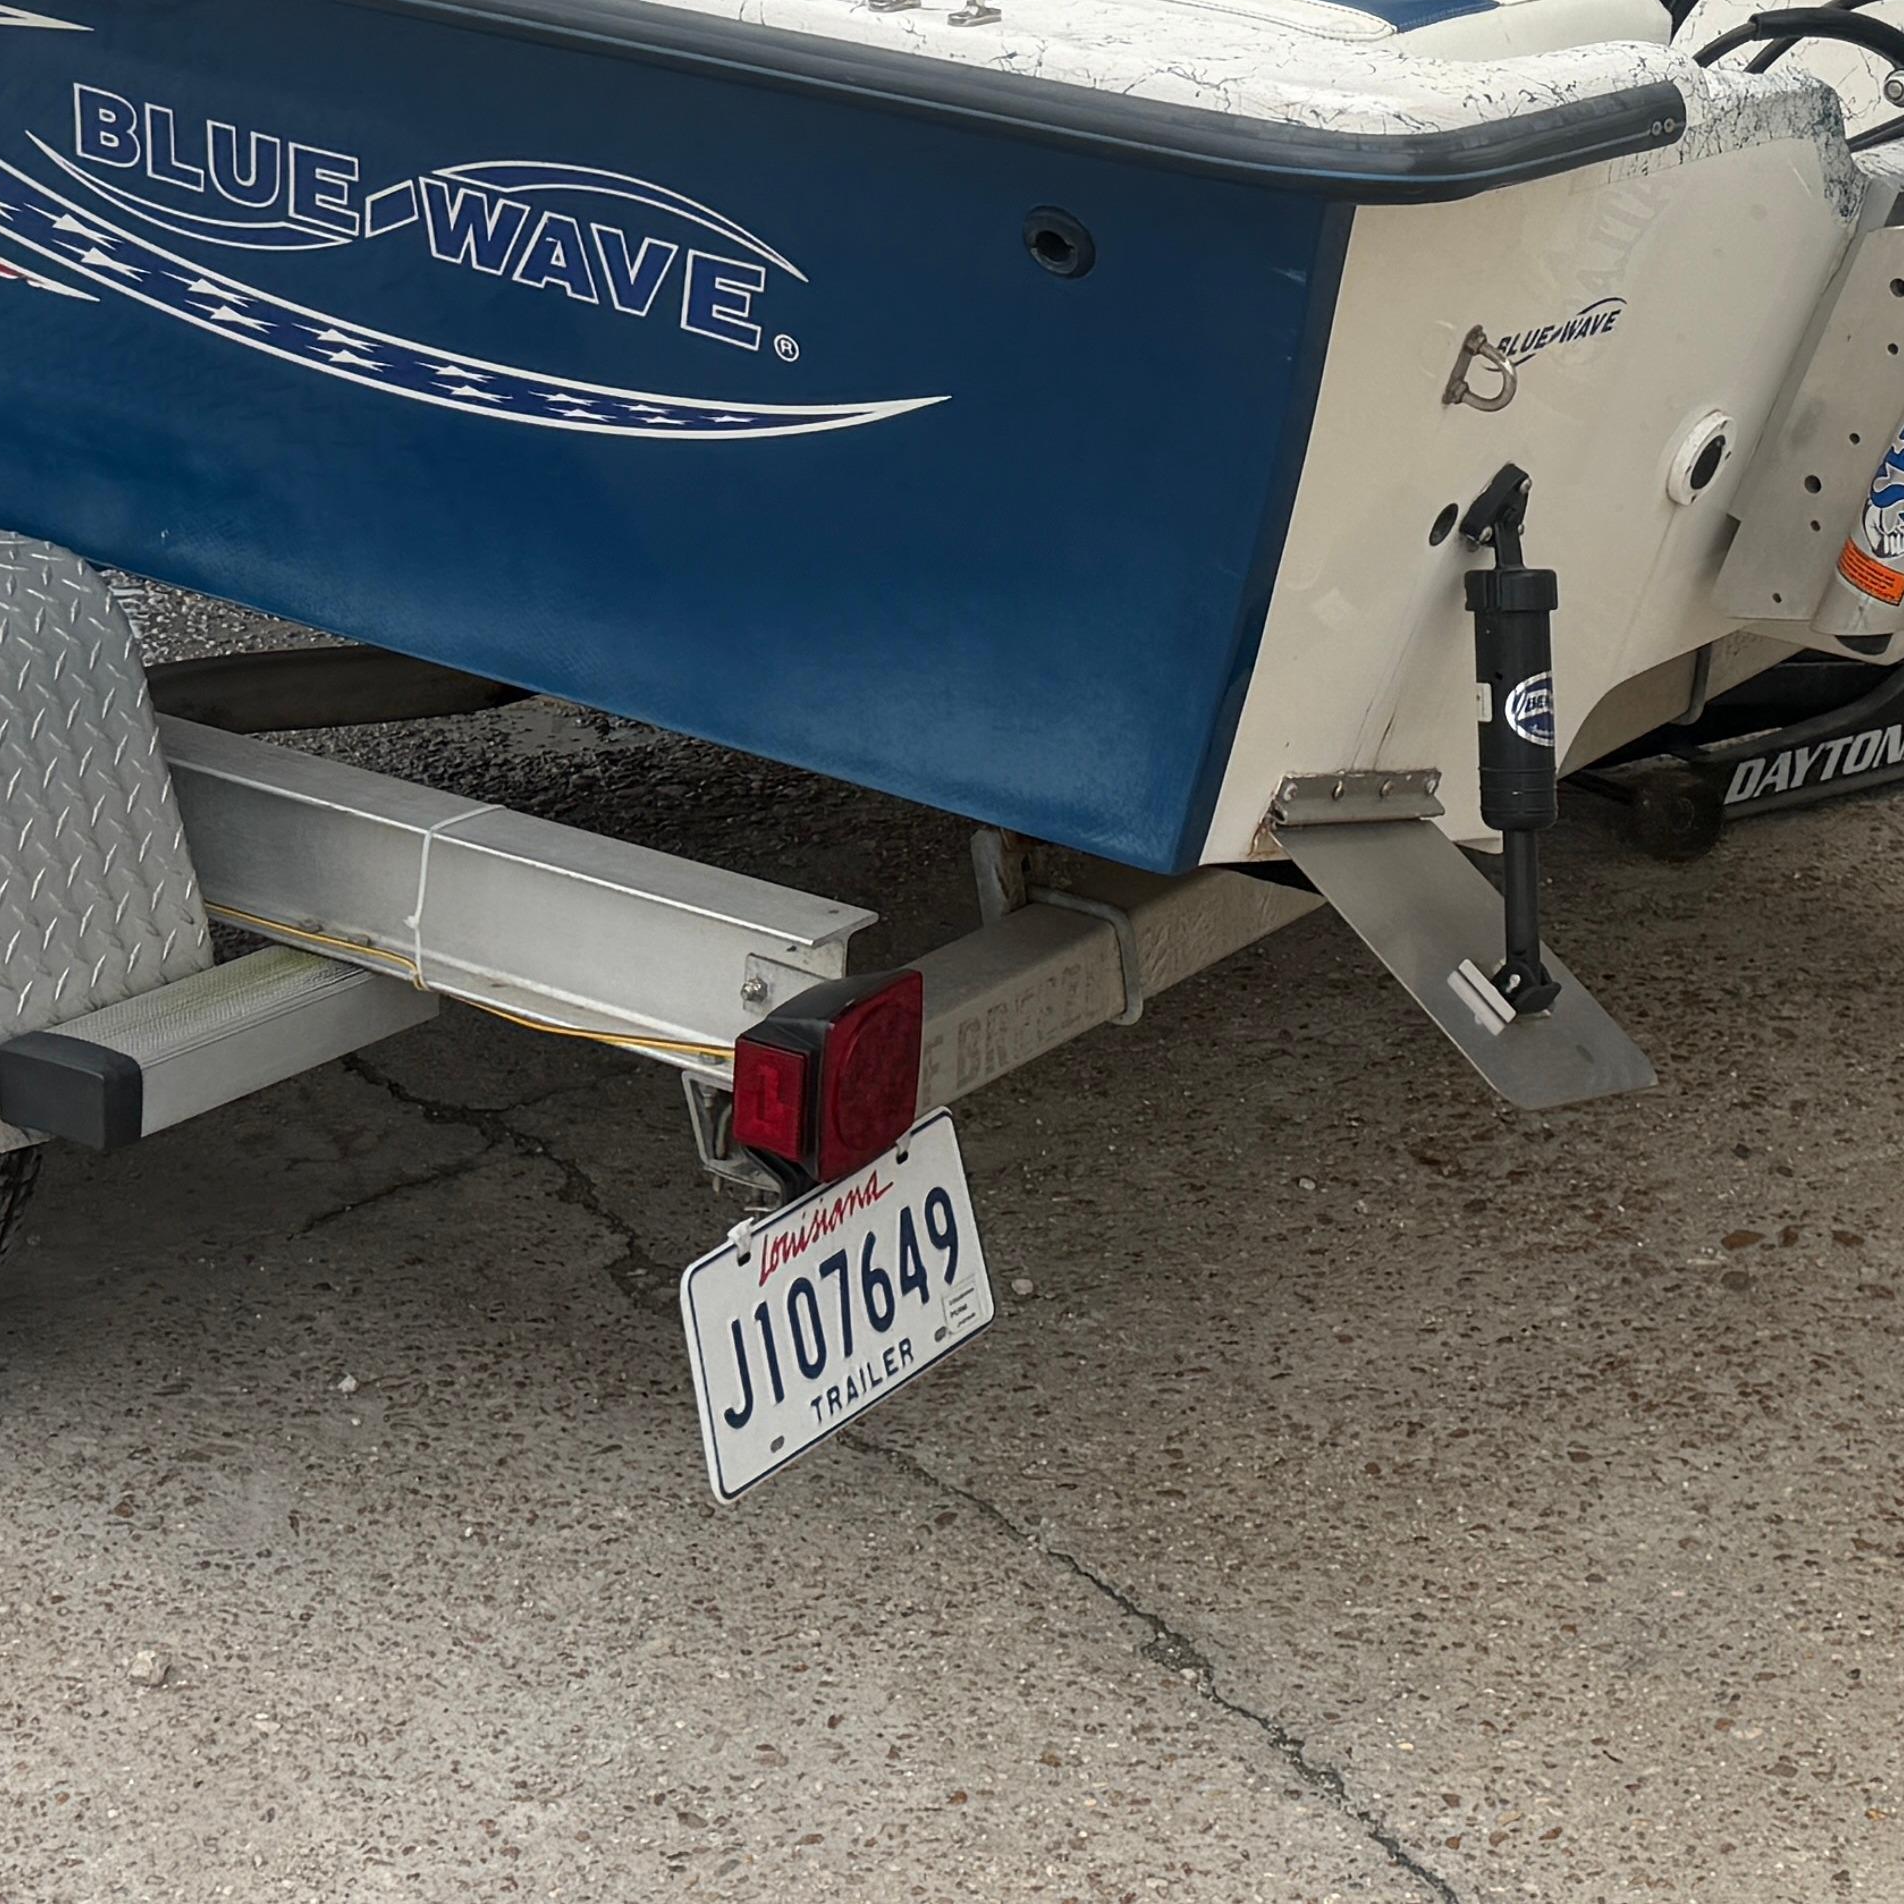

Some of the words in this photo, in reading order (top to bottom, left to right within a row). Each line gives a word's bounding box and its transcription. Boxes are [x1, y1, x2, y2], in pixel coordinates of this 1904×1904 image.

[73, 82, 360, 238] BLUE
[419, 176, 766, 351] WAVE
[1558, 309, 1622, 344] WAVE
[759, 1170, 894, 1287] Louisiana
[724, 1187, 959, 1430] J107649
[810, 1337, 914, 1424] TRAILER
